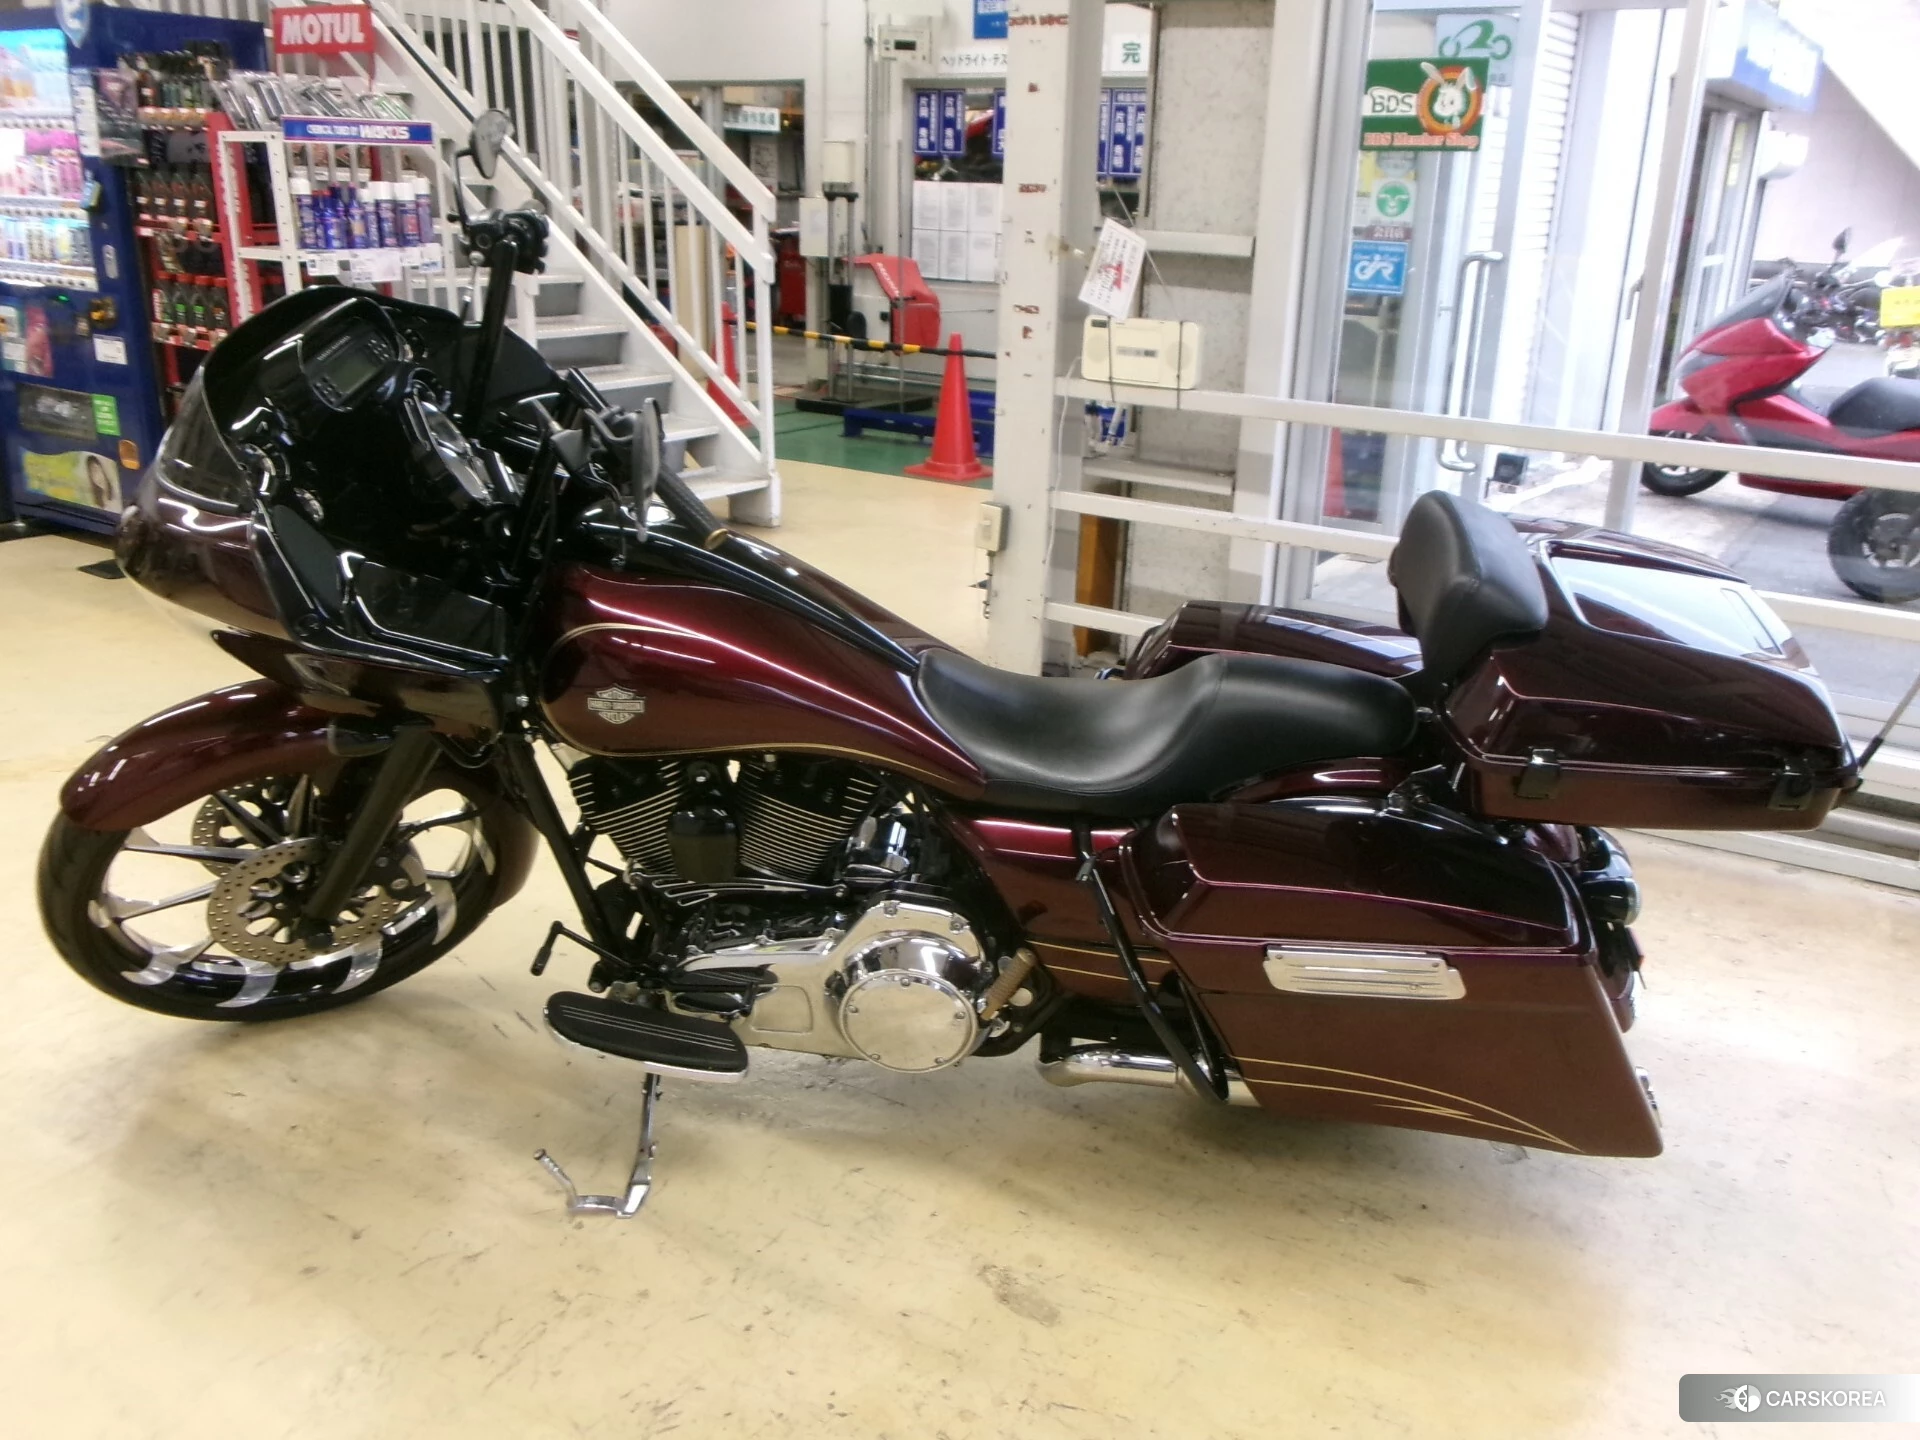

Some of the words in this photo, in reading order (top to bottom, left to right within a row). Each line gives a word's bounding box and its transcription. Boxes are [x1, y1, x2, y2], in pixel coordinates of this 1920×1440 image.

[281, 12, 365, 45] MOTUL
[1122, 42, 1141, 64] 完
[1371, 94, 1413, 113] BDS
[1363, 132, 1391, 146] BDS
[1393, 132, 1444, 146] Member
[1445, 132, 1480, 149] Shop
